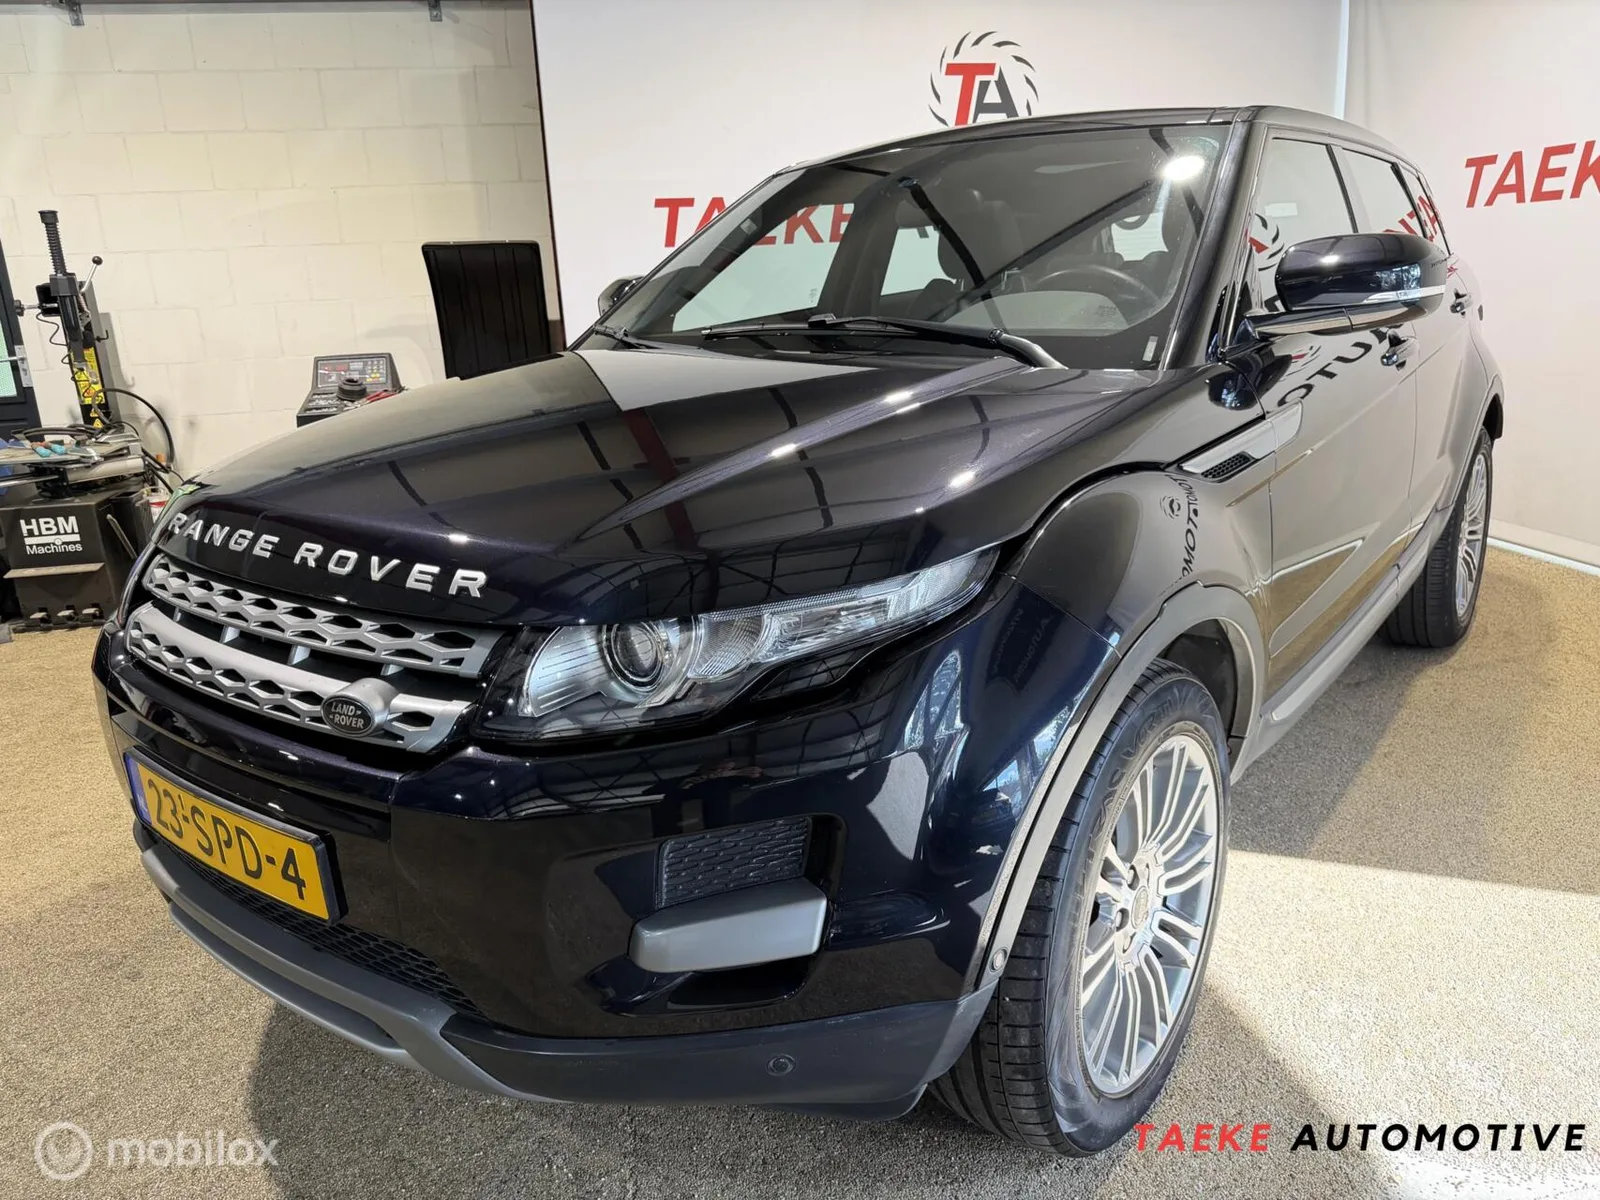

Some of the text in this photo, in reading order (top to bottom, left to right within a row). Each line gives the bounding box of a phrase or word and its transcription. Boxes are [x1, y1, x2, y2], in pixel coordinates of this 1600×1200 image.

[944, 62, 1020, 126] TA
[1464, 139, 1600, 208] TAEK
[653, 196, 855, 248] TAKE
[20, 515, 79, 536] HBM
[26, 543, 83, 555] Machines
[168, 511, 487, 598] RANGE ROVER
